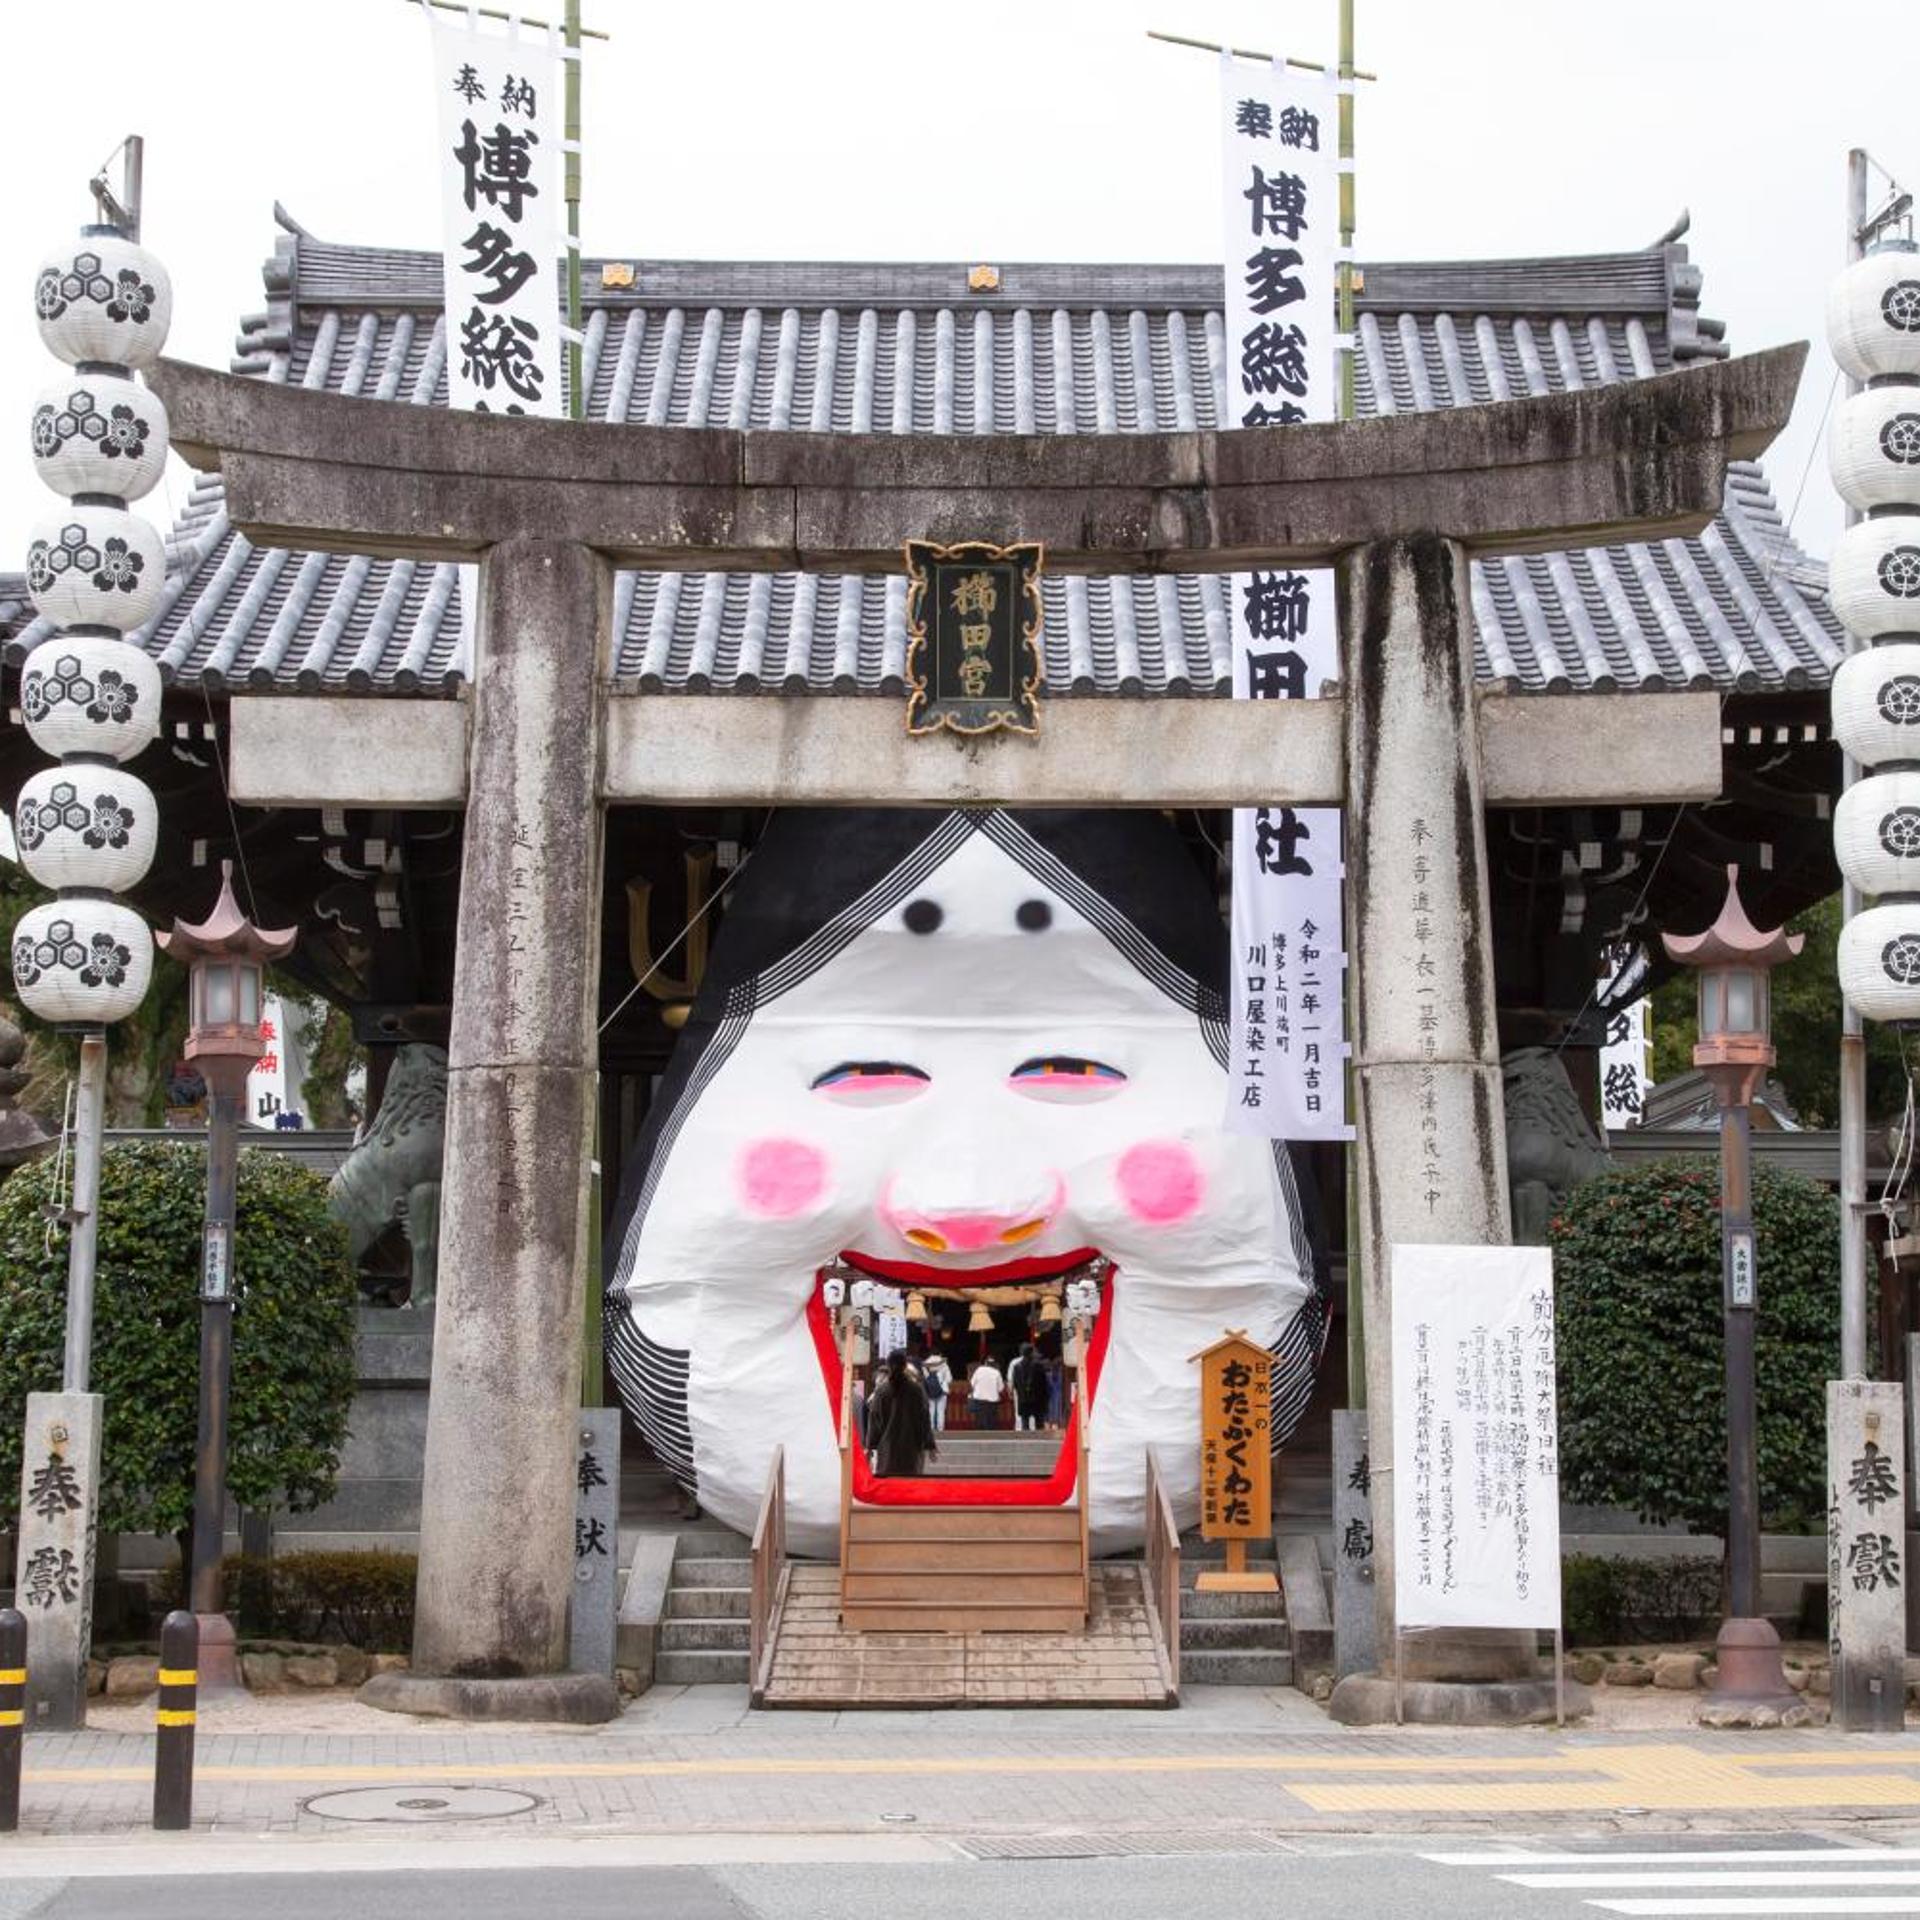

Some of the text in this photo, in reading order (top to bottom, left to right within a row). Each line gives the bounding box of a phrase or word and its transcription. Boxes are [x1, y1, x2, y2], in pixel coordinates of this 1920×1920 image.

[453, 63, 537, 120] 奉納
[1236, 98, 1320, 152] 奉納
[950, 571, 997, 695] 櫛田宮
[1241, 943, 1266, 1107] 川口屋染工店
[1272, 932, 1289, 1053] 博多上川端町
[1299, 918, 1322, 1112] 令和二年一月吉日
[1221, 1359, 1253, 1527] おたふくわた
[1254, 1362, 1269, 1430] 日本一の
